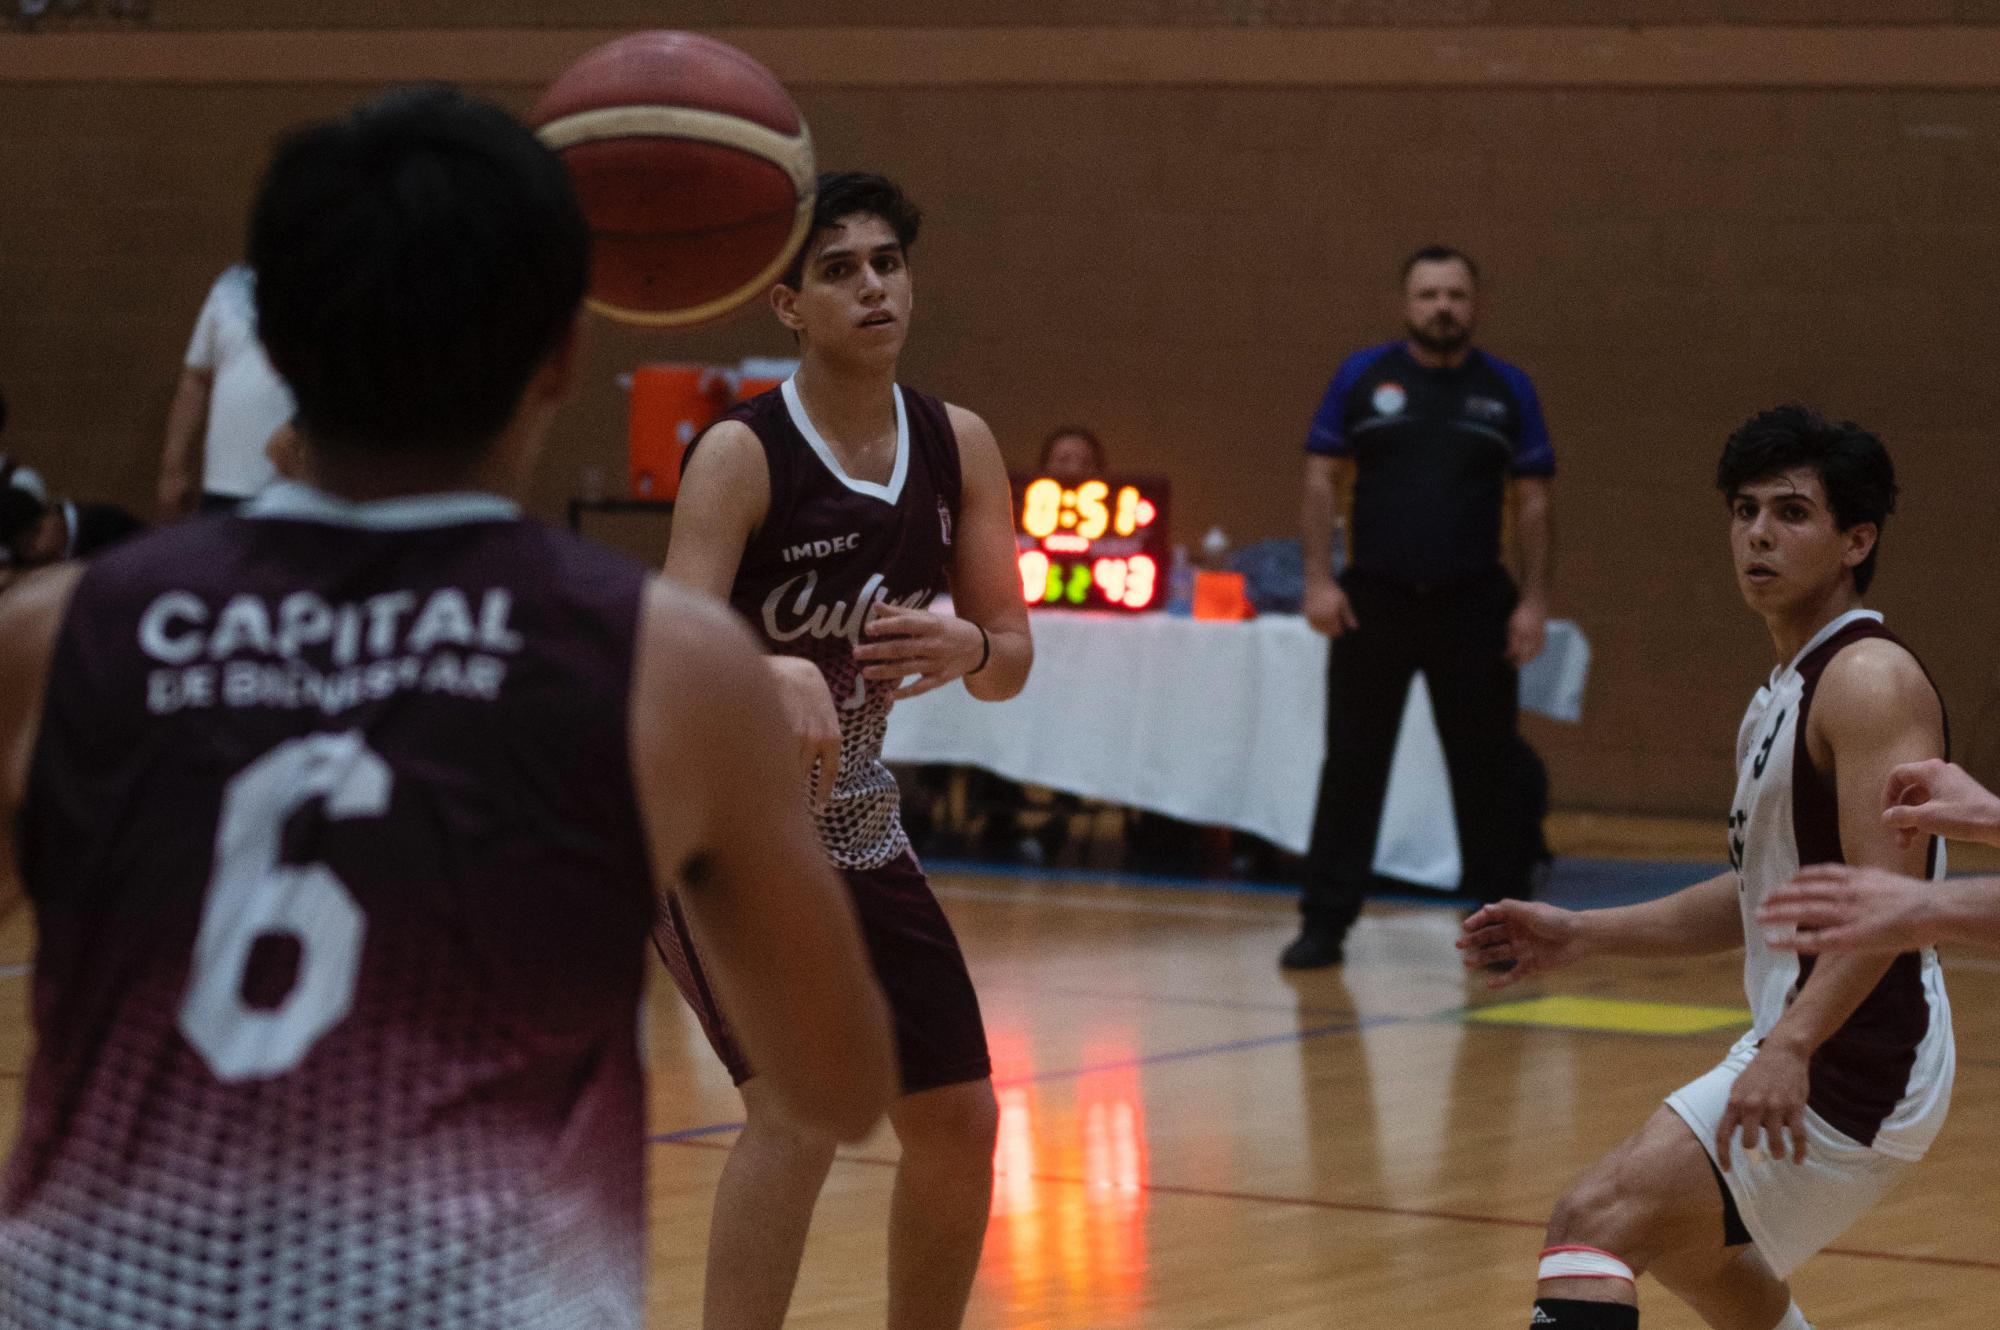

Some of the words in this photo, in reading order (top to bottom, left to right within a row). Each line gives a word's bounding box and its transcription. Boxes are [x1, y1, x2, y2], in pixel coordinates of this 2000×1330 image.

[781, 531, 861, 563] IMDEC
[137, 586, 524, 666] CAPITAL
[180, 731, 392, 1082] 6
